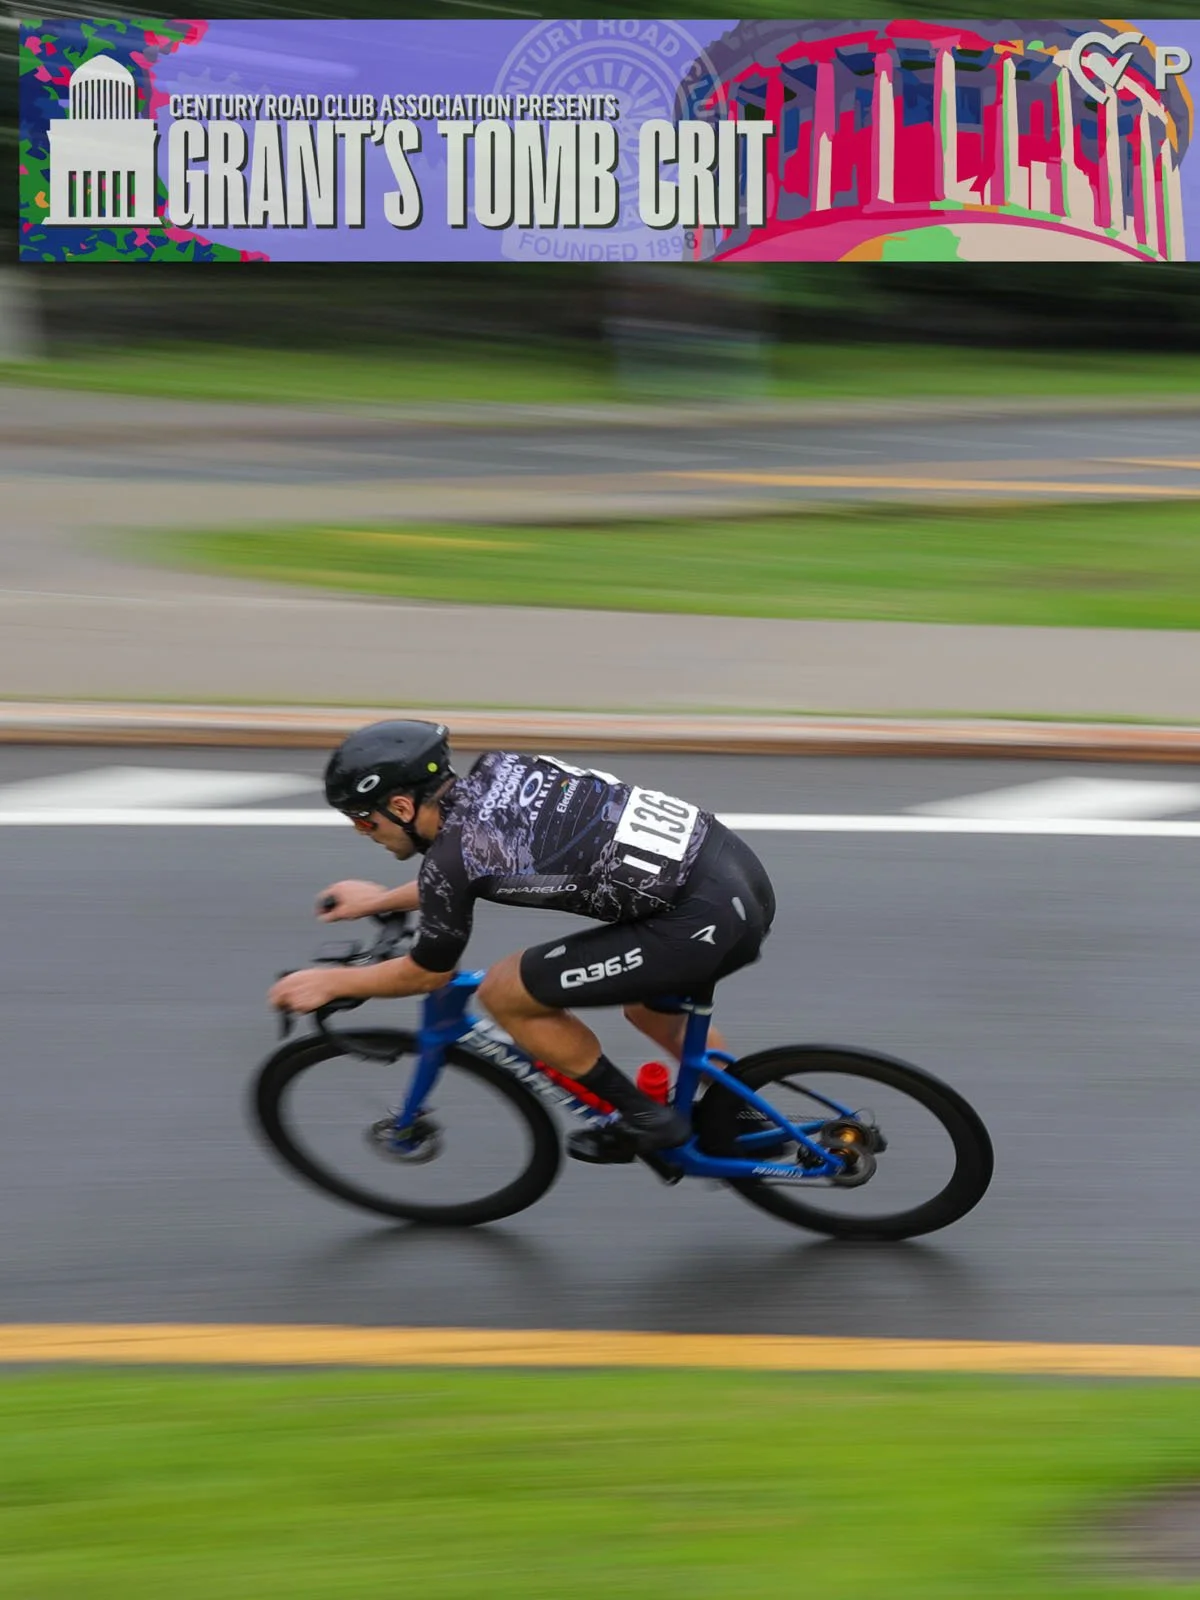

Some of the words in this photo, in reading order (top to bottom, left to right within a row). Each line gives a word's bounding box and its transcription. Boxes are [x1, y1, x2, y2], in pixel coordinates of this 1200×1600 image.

[529, 767, 560, 821] OAKLEY
[629, 793, 690, 845] 136
[496, 883, 578, 895] PINARELLO
[560, 947, 644, 990] Q36.5
